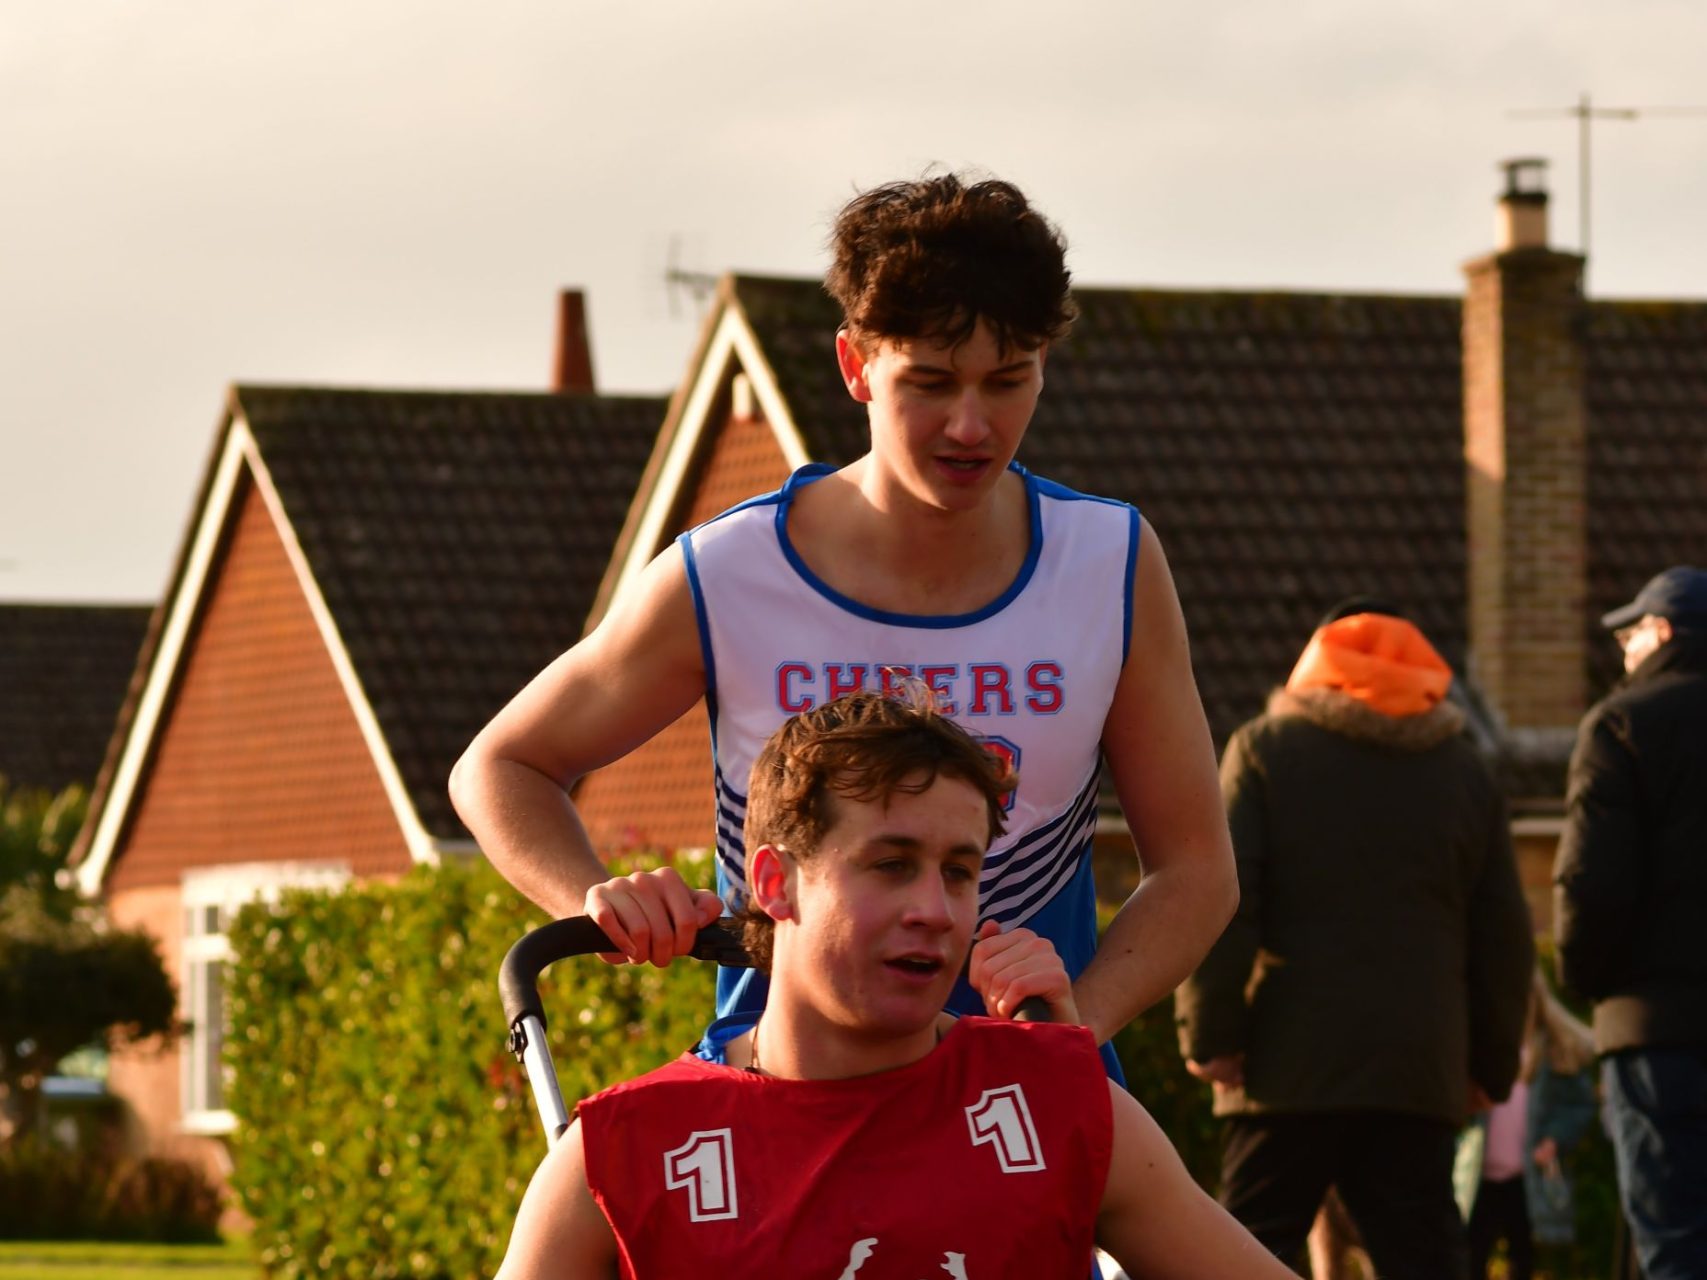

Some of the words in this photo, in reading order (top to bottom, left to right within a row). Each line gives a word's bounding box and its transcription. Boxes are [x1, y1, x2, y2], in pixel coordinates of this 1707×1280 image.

[774, 660, 1065, 716] CHEERS
[964, 1083, 1047, 1174] 1
[663, 1127, 739, 1223] 1
